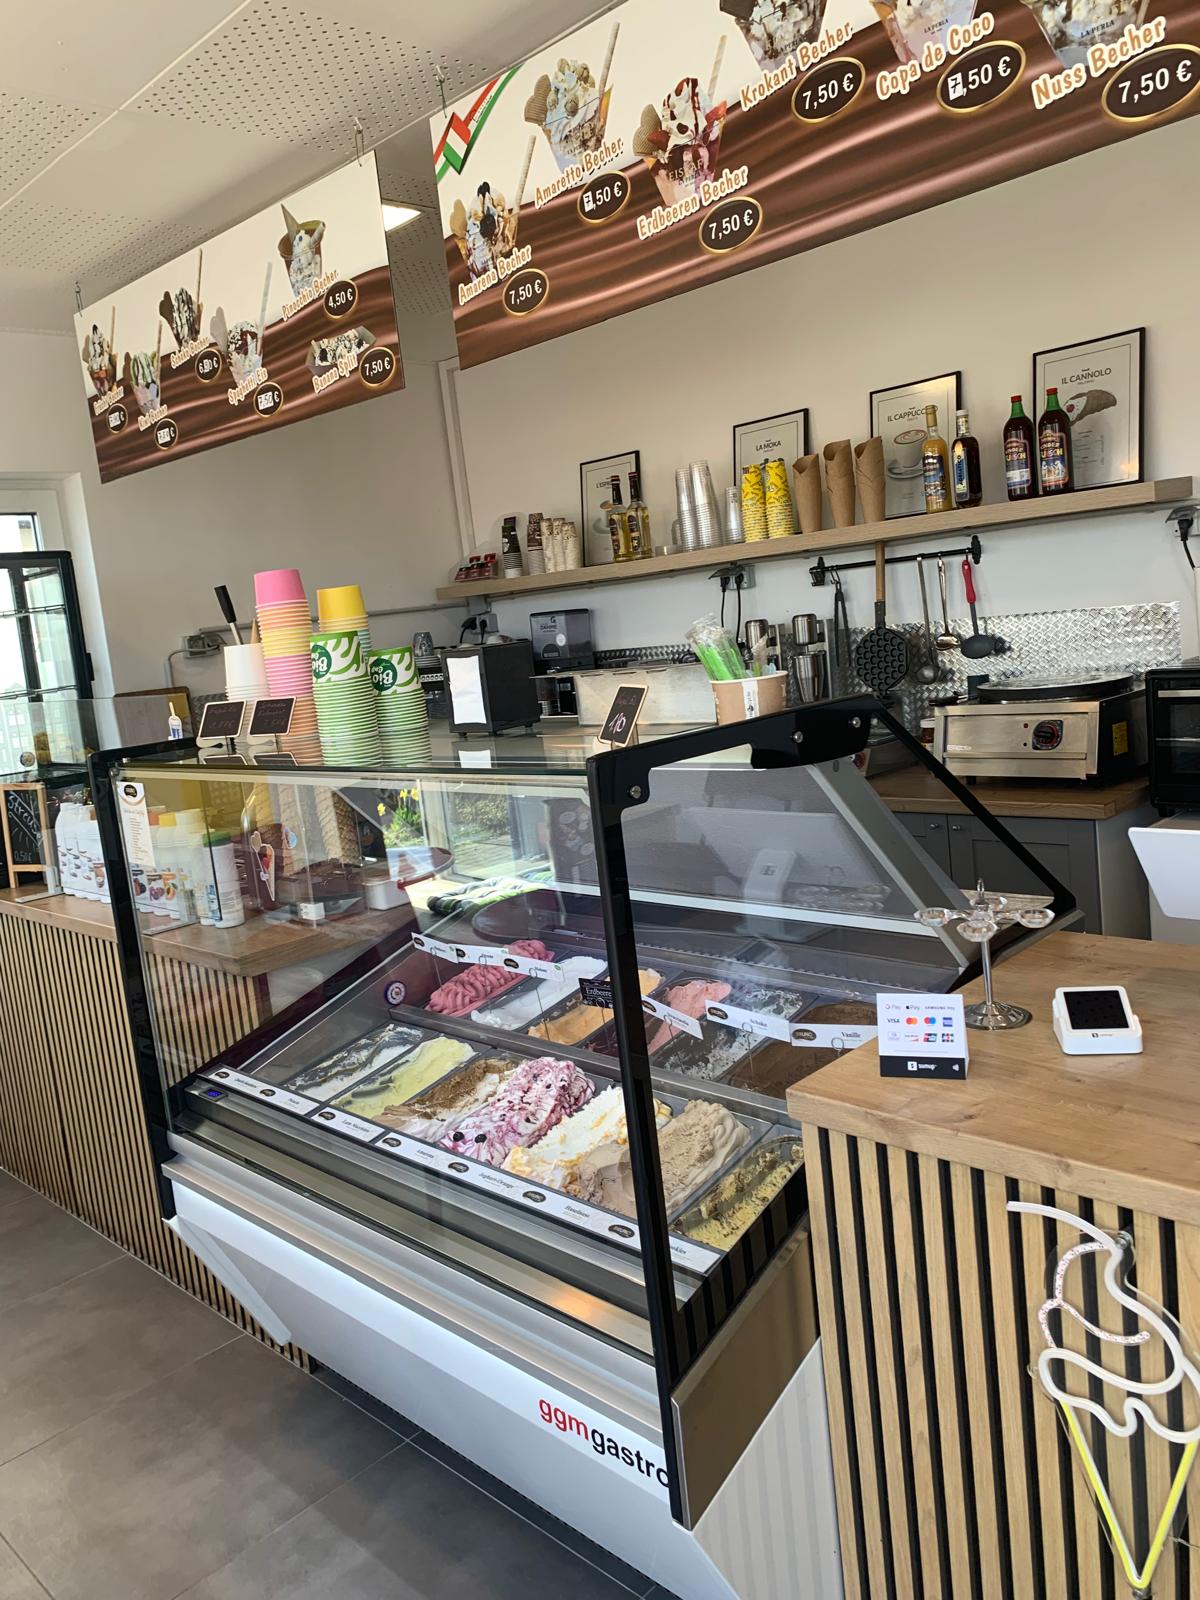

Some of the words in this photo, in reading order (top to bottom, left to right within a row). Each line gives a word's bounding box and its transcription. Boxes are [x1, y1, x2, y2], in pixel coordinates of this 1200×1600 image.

[740, 62, 797, 111] Krokant
[799, 20, 852, 68] Becher
[876, 61, 921, 100] Copa
[922, 40, 946, 69] de
[948, 12, 995, 51] Coco
[1031, 64, 1087, 109] Nuss
[1088, 16, 1167, 77] Becher
[802, 79, 840, 110] 7,50
[842, 73, 855, 92] €
[948, 65, 993, 99] 7,50
[997, 56, 1012, 77] €
[1118, 68, 1171, 104] 7,50
[1175, 59, 1192, 82] €
[534, 165, 582, 209] Amaretto
[583, 138, 624, 173] Becher
[612, 181, 623, 198] €
[637, 197, 699, 241] Erdbeeren
[700, 166, 748, 203] Becher
[709, 213, 741, 240] 7,50
[743, 209, 755, 227] €
[458, 270, 497, 305] Amarena
[498, 246, 532, 281] Becher
[328, 292, 346, 309] 4,50
[346, 288, 354, 302] €
[509, 285, 533, 305] 7,50
[534, 280, 543, 295] €
[312, 366, 339, 394] Banana
[338, 352, 358, 378] Split
[364, 361, 383, 377] 7,50
[383, 356, 391, 371] €
[1061, 377, 1069, 385] IL
[1069, 367, 1112, 383] CANNOLO
[893, 407, 926, 421] CAPPUCC
[763, 440, 782, 449] MOKA
[312, 656, 328, 673] Bio
[372, 669, 394, 686] Bio
[585, 987, 612, 997] Erdbeere
[840, 1031, 861, 1039] Vanille
